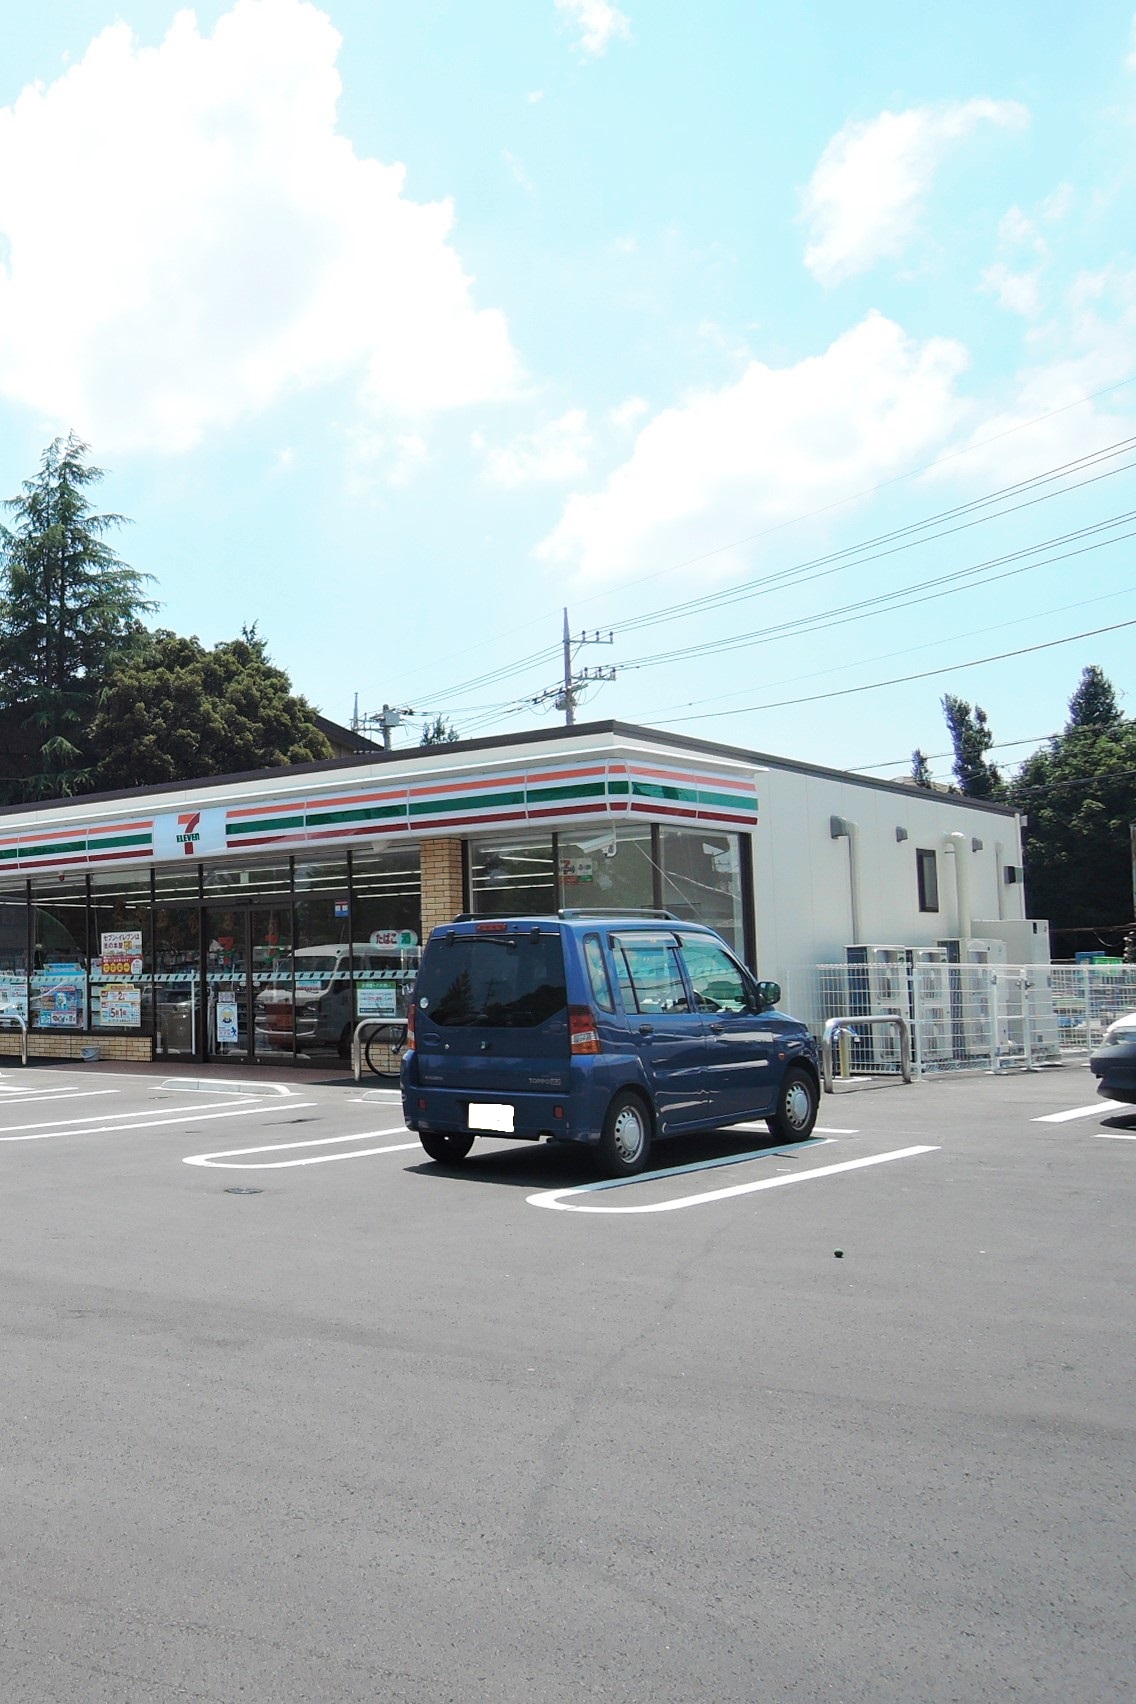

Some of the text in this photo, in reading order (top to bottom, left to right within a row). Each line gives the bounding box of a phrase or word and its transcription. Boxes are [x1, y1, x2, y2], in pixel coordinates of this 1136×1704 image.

[177, 812, 201, 855] 7
[375, 932, 398, 945] たばこ
